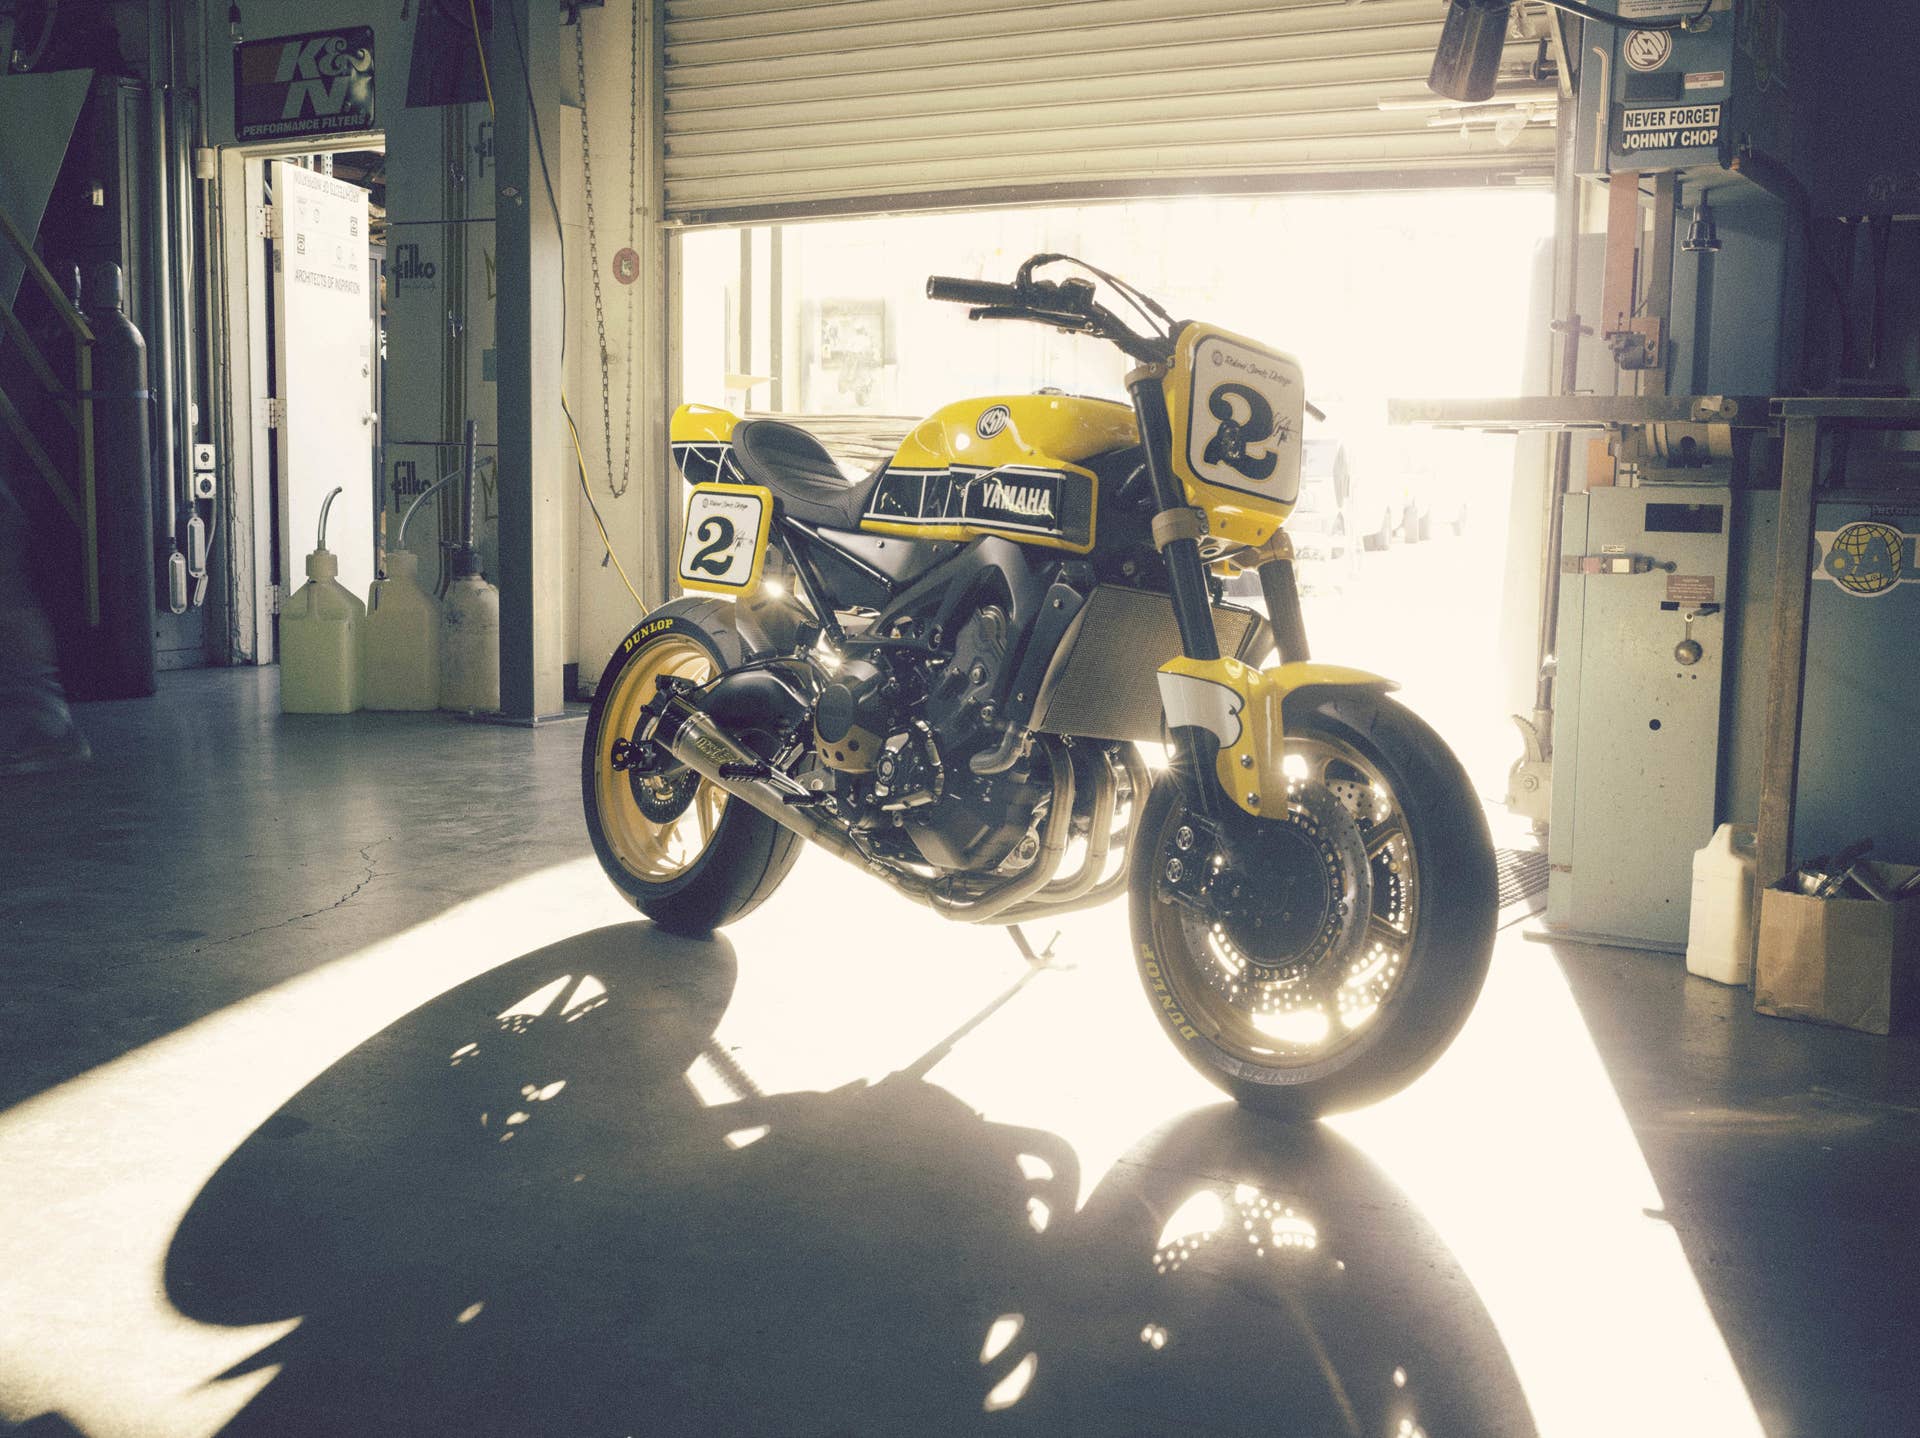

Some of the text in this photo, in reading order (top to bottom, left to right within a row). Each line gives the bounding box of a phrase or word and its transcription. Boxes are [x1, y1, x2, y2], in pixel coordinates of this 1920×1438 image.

[242, 114, 366, 137] PERFORMANCE FILTERS
[1625, 107, 1719, 128] NEVER FORGET
[1622, 129, 1718, 149] JOHNNY CHOP
[391, 243, 437, 299] filko
[1203, 382, 1278, 480] 2
[982, 483, 1052, 515] YAMAHA
[690, 516, 734, 576] 2
[623, 618, 673, 653] DUNLOP
[1141, 943, 1199, 1041] DUNLOP
